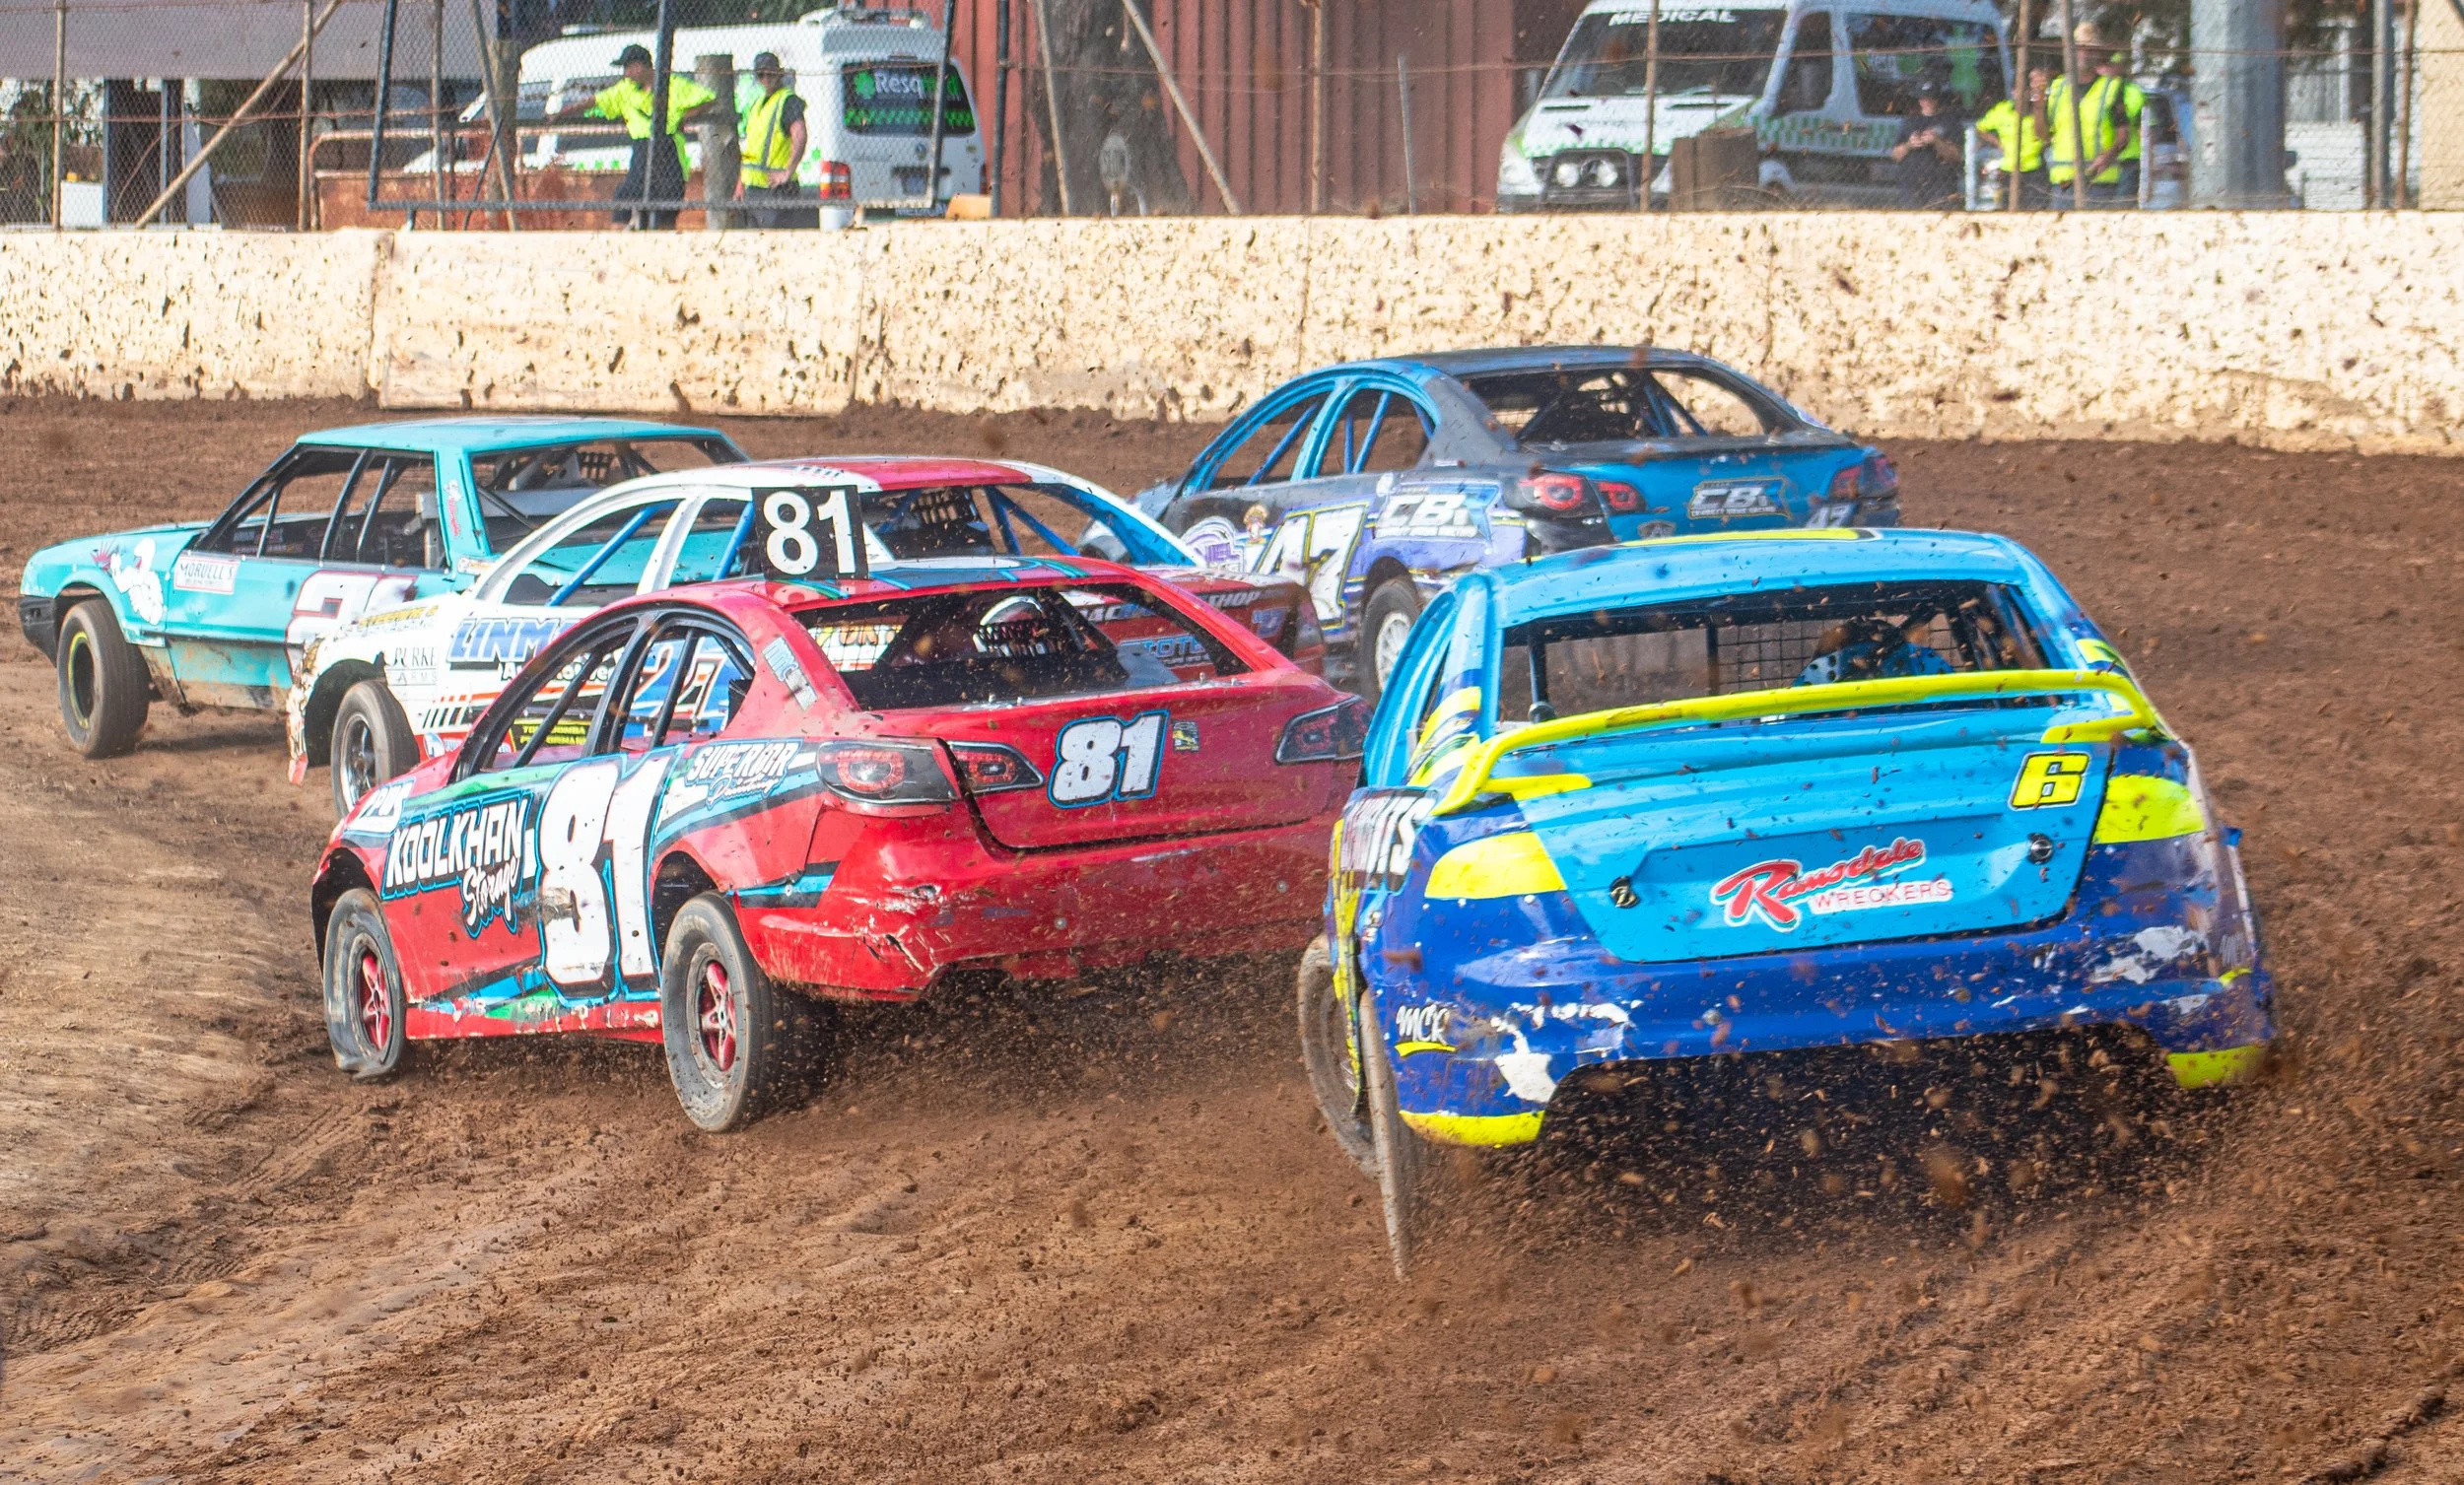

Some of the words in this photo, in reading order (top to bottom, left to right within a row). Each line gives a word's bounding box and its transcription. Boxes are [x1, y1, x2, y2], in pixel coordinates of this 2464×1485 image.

[763, 489, 856, 575] 81
[1258, 503, 1368, 626] 47
[446, 618, 583, 663] LINM
[687, 742, 800, 781] SUPERIOR
[1052, 714, 1161, 802] 81
[2011, 753, 2089, 808] 6
[384, 798, 528, 887] KOOLKHAN
[539, 754, 671, 985] 81
[462, 854, 520, 926] Storage
[1814, 881, 1949, 910] WRECKERS
